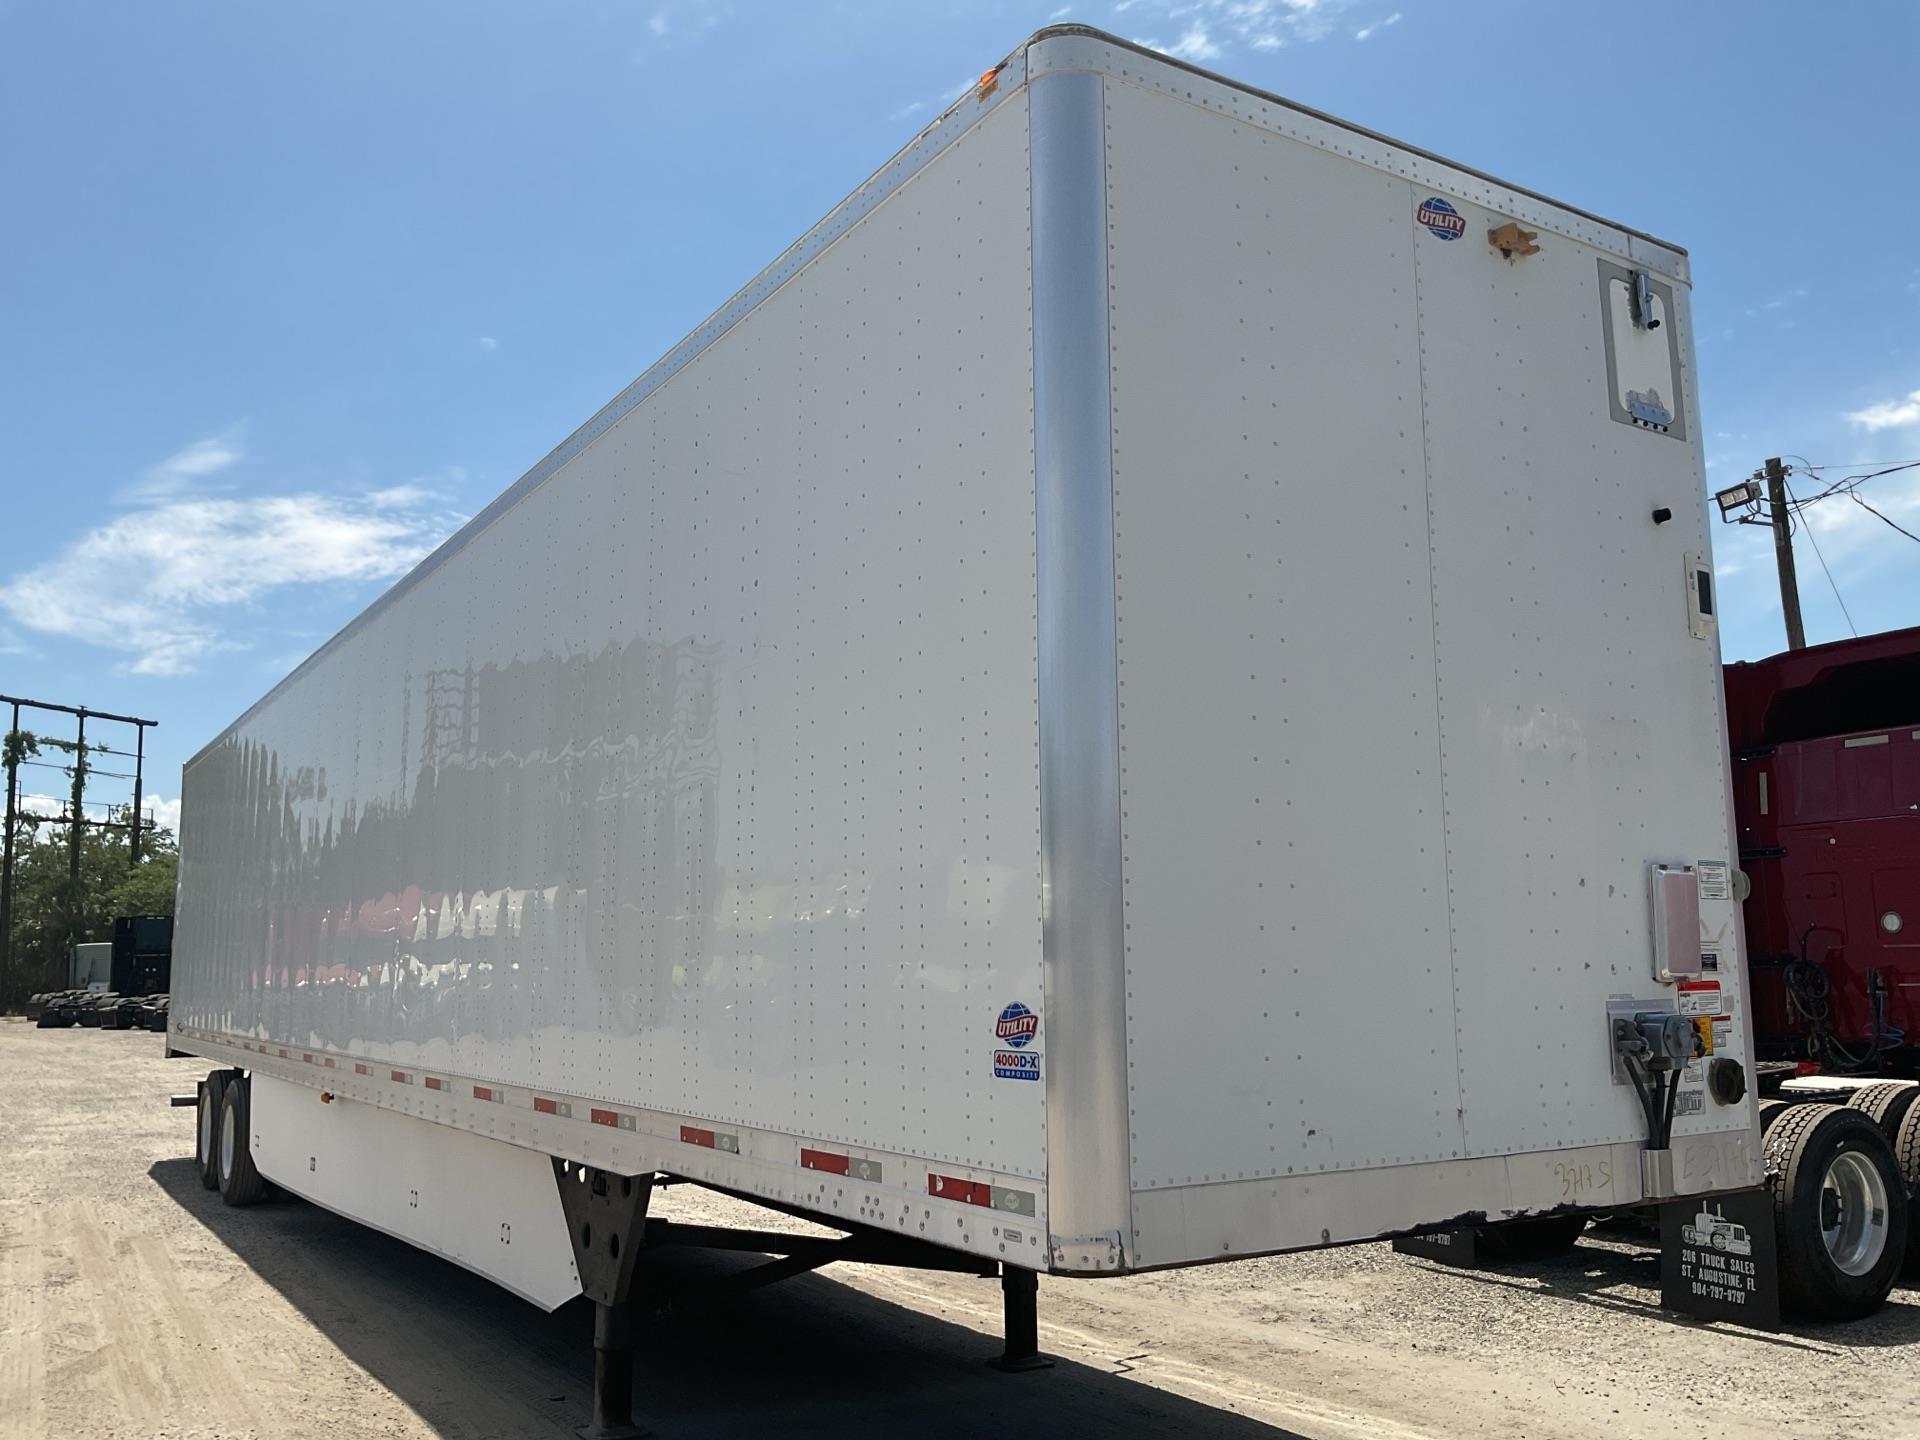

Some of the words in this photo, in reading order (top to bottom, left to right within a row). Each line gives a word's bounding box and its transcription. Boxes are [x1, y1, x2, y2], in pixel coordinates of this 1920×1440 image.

[1420, 210, 1463, 230] UTILITY
[998, 1017, 1036, 1036] UTILITY
[995, 1054, 1037, 1069] 4000D-X
[996, 1069, 1038, 1079] COMPOSITE
[1682, 1249, 1696, 1263] 206
[1700, 1252, 1726, 1269] TRUCK
[1730, 1258, 1756, 1275] SALES
[1681, 1264, 1694, 1278] ST.
[1698, 1267, 1743, 1288] AUGUSTINE,
[1746, 1277, 1757, 1291] FL
[1691, 1281, 1746, 1304] 904-797-9797
